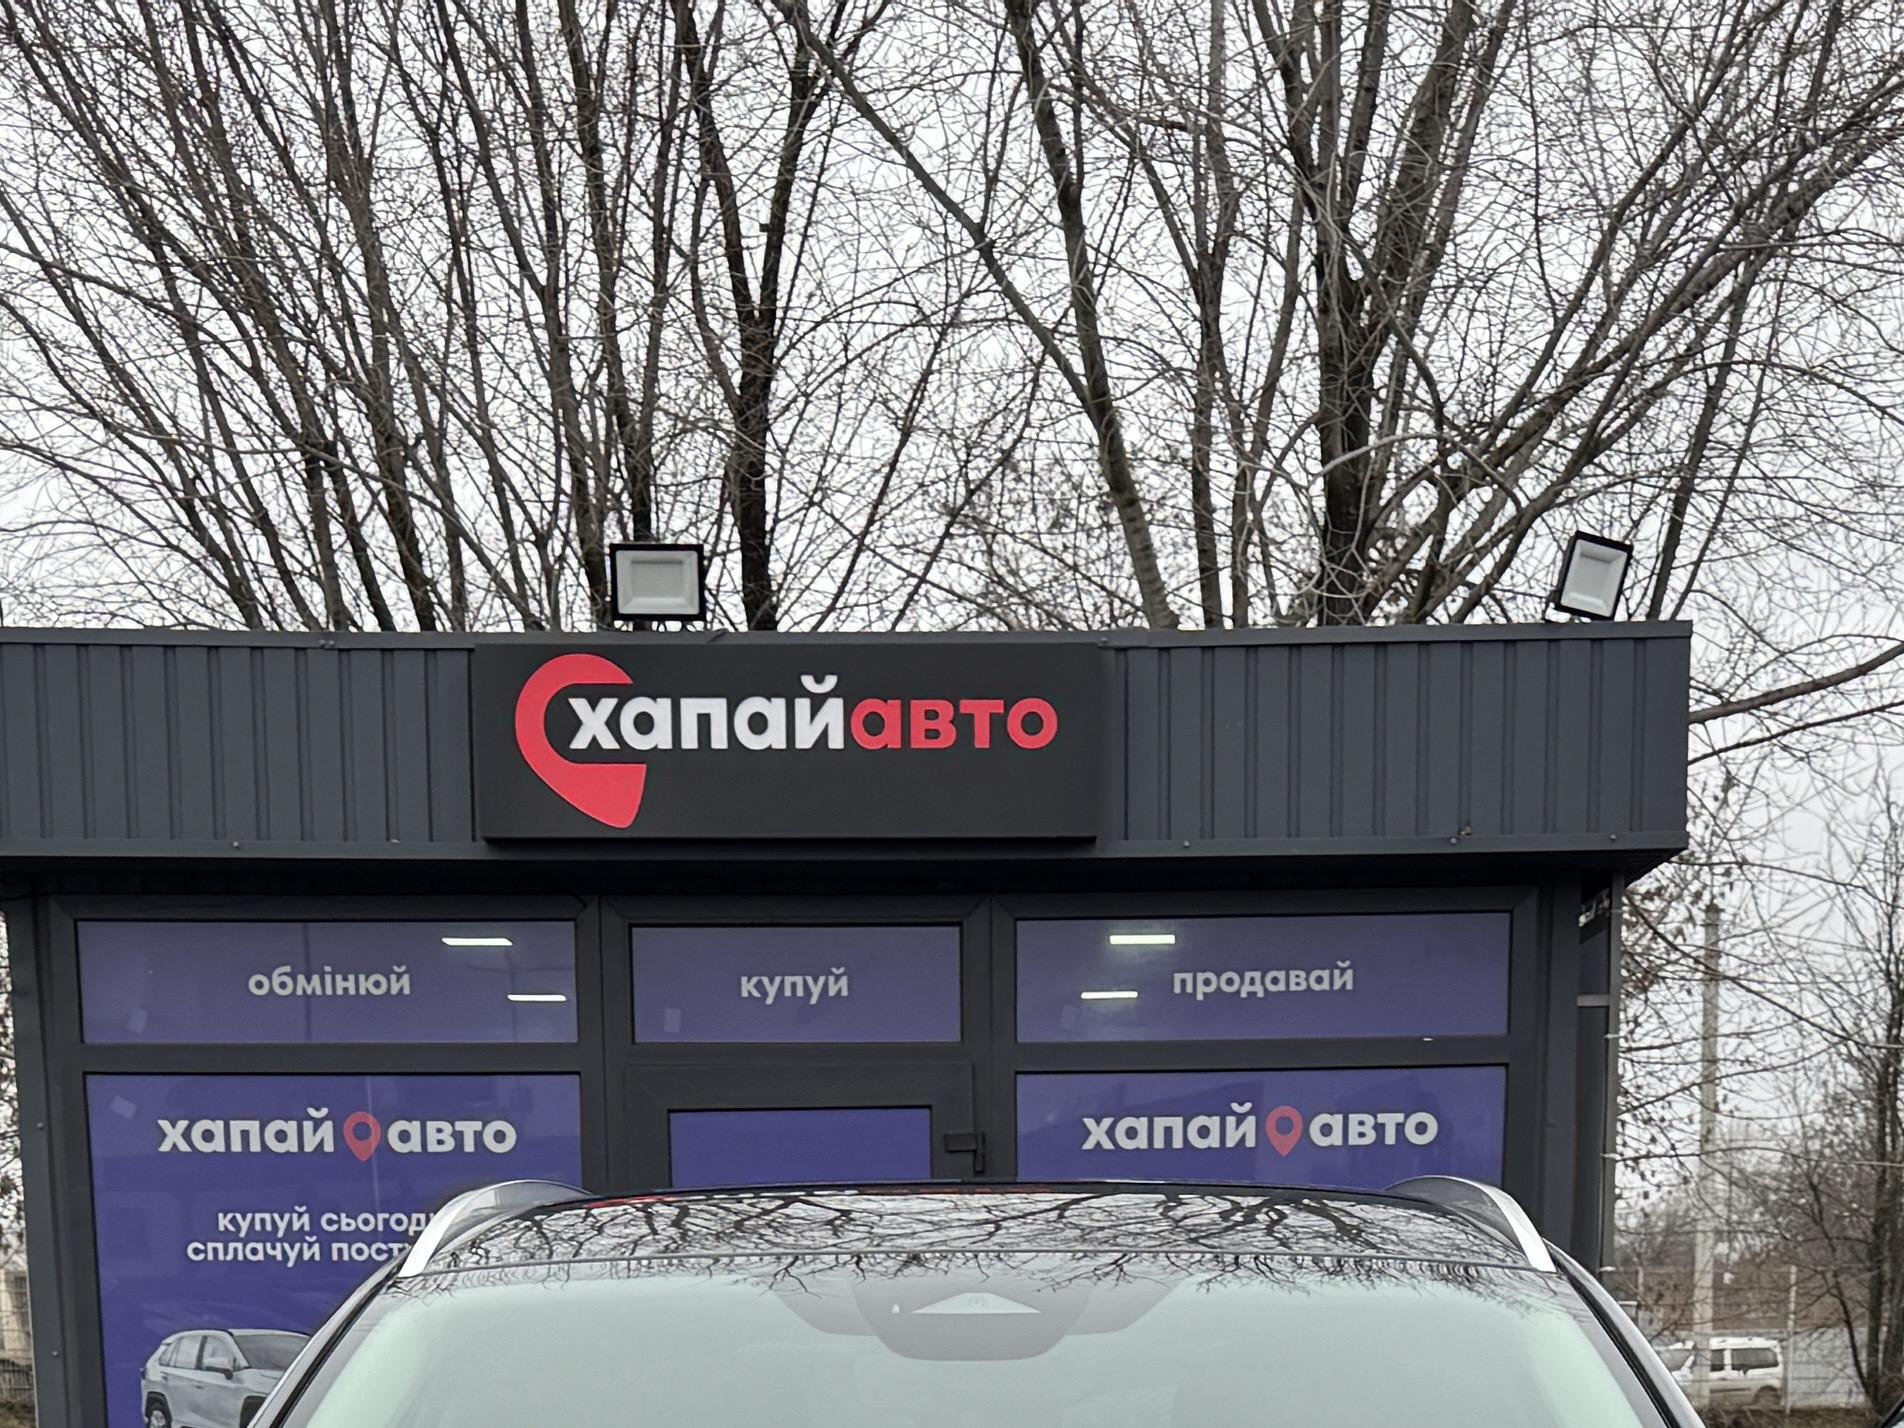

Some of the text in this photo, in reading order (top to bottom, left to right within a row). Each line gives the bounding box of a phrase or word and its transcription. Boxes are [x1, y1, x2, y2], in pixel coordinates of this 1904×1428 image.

[248, 964, 411, 996] обмінюй
[741, 966, 848, 1005] купуй
[1173, 959, 1354, 1001] продавай
[157, 1106, 517, 1154] хапай авто
[1082, 1102, 1439, 1150] хапай авто
[217, 1205, 434, 1238] купуй сьогод
[186, 1235, 321, 1268] сплачуй
